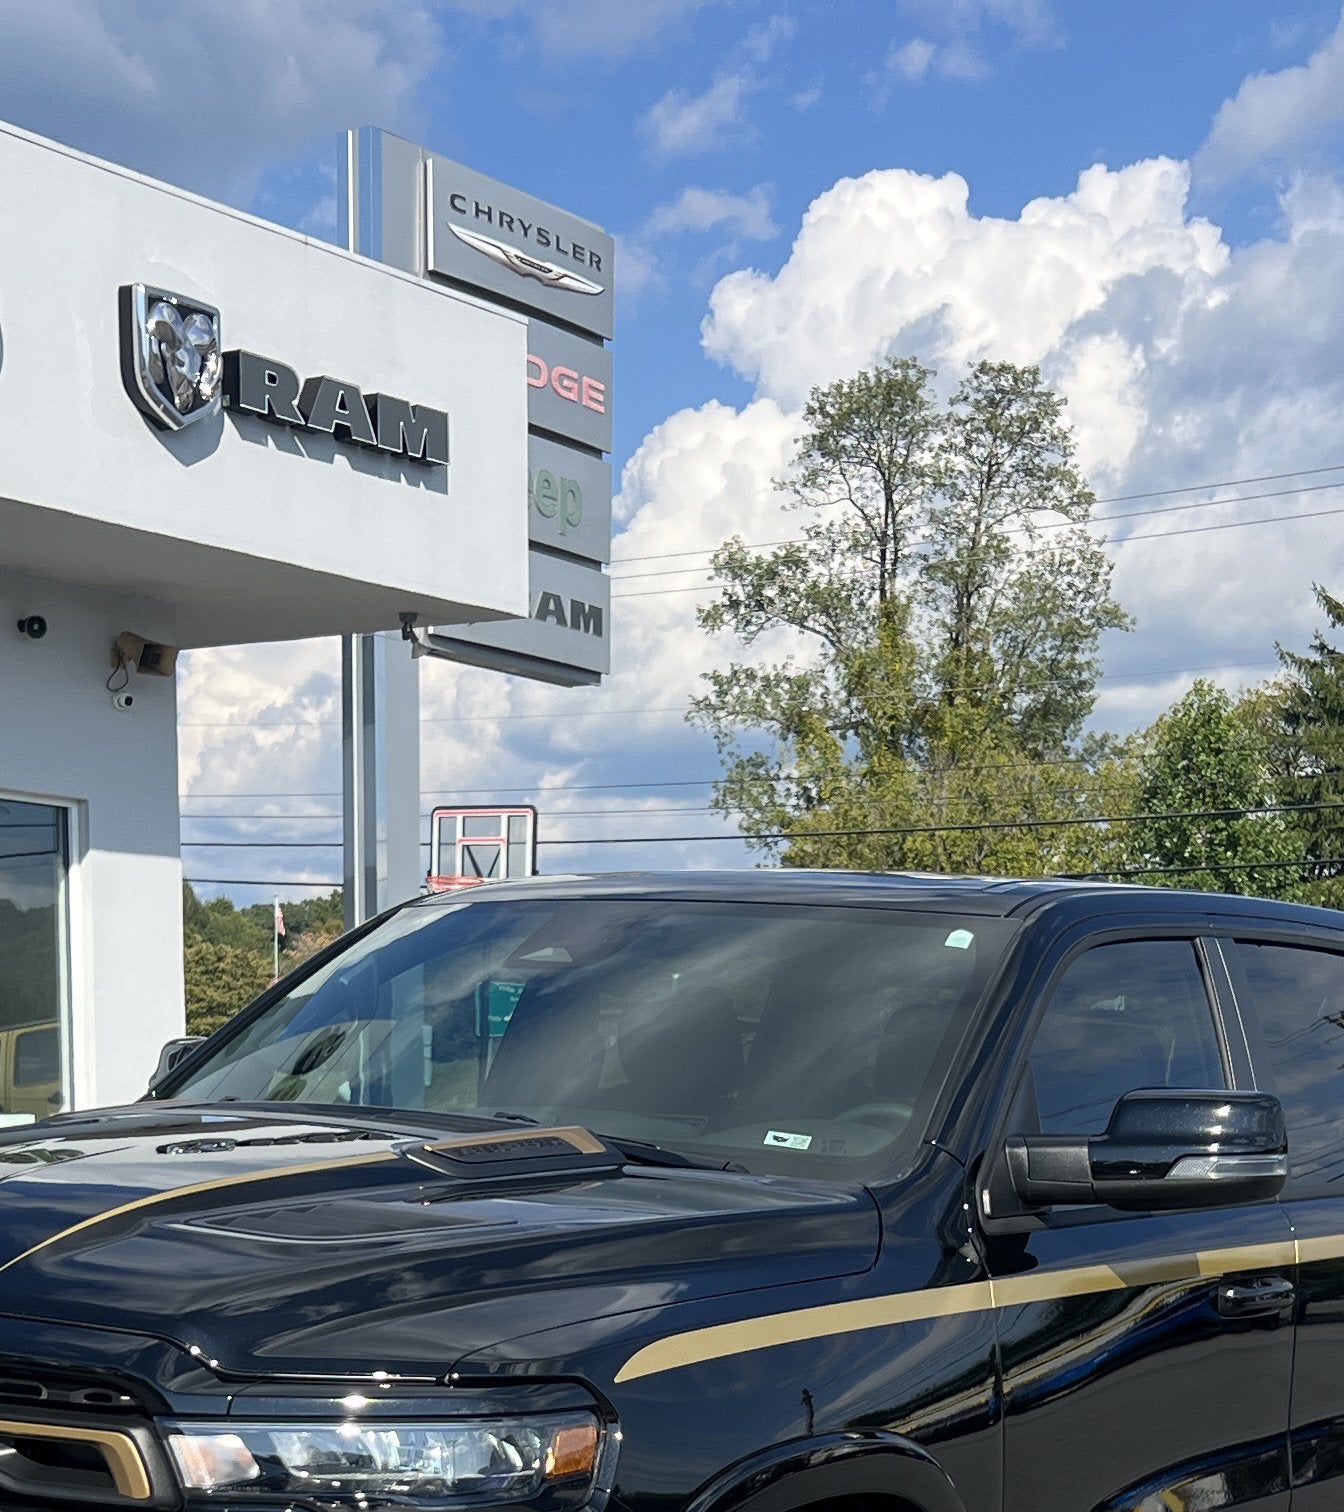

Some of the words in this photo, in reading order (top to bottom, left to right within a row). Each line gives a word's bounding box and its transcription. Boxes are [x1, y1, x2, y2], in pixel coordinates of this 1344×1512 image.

[449, 193, 602, 272] CHRYSLER
[224, 349, 450, 466] RAM
[527, 353, 606, 414] DGE
[529, 468, 584, 537] ep
[530, 590, 604, 638] AM
